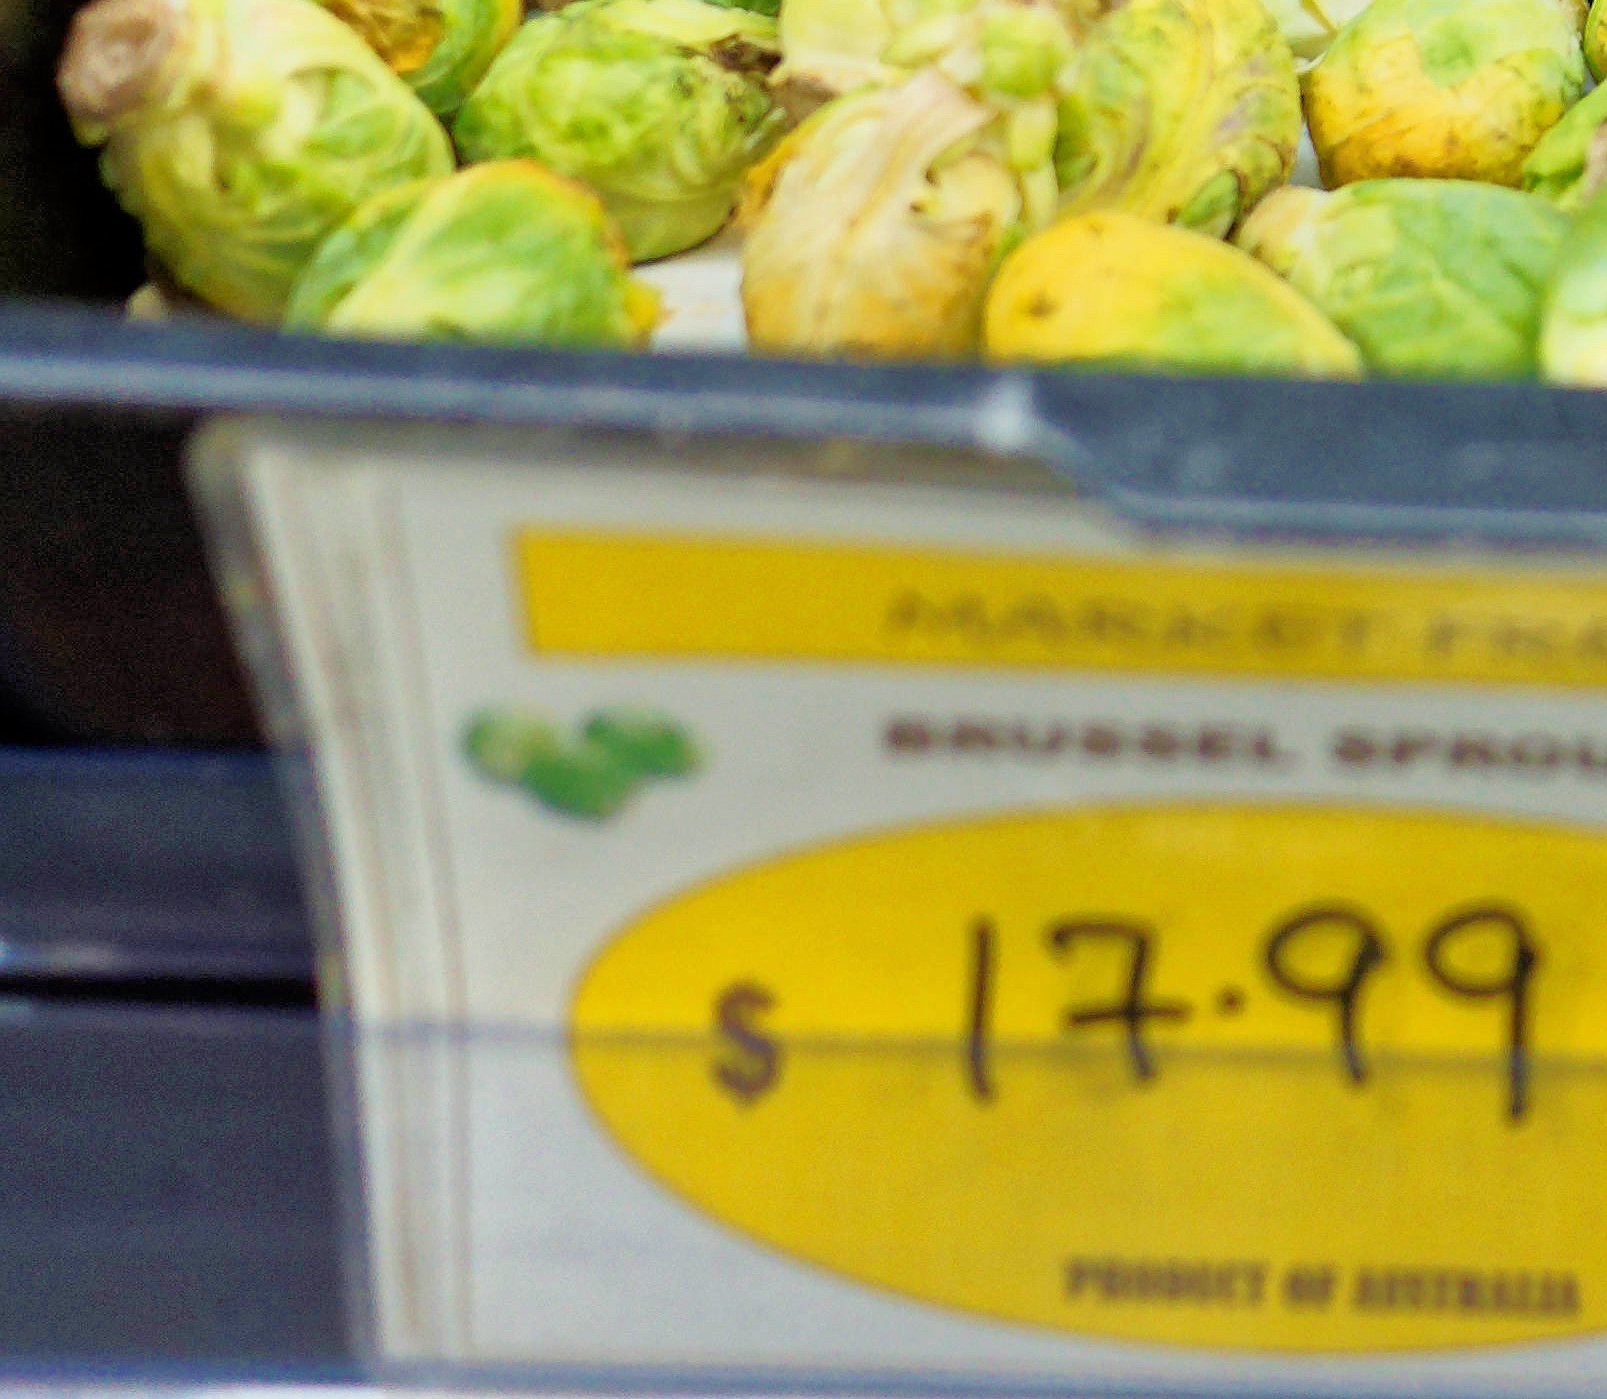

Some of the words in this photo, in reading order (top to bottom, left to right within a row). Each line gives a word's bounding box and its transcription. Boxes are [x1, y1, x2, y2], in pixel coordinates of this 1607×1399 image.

[882, 710, 1300, 766] BRUSSEL
[710, 978, 784, 1108] $
[964, 902, 1542, 1126] 17.99
[1063, 1256, 1269, 1305] PRODUCT
[1282, 1262, 1338, 1311] OF
[1353, 1266, 1581, 1320] AUSTRALIA
